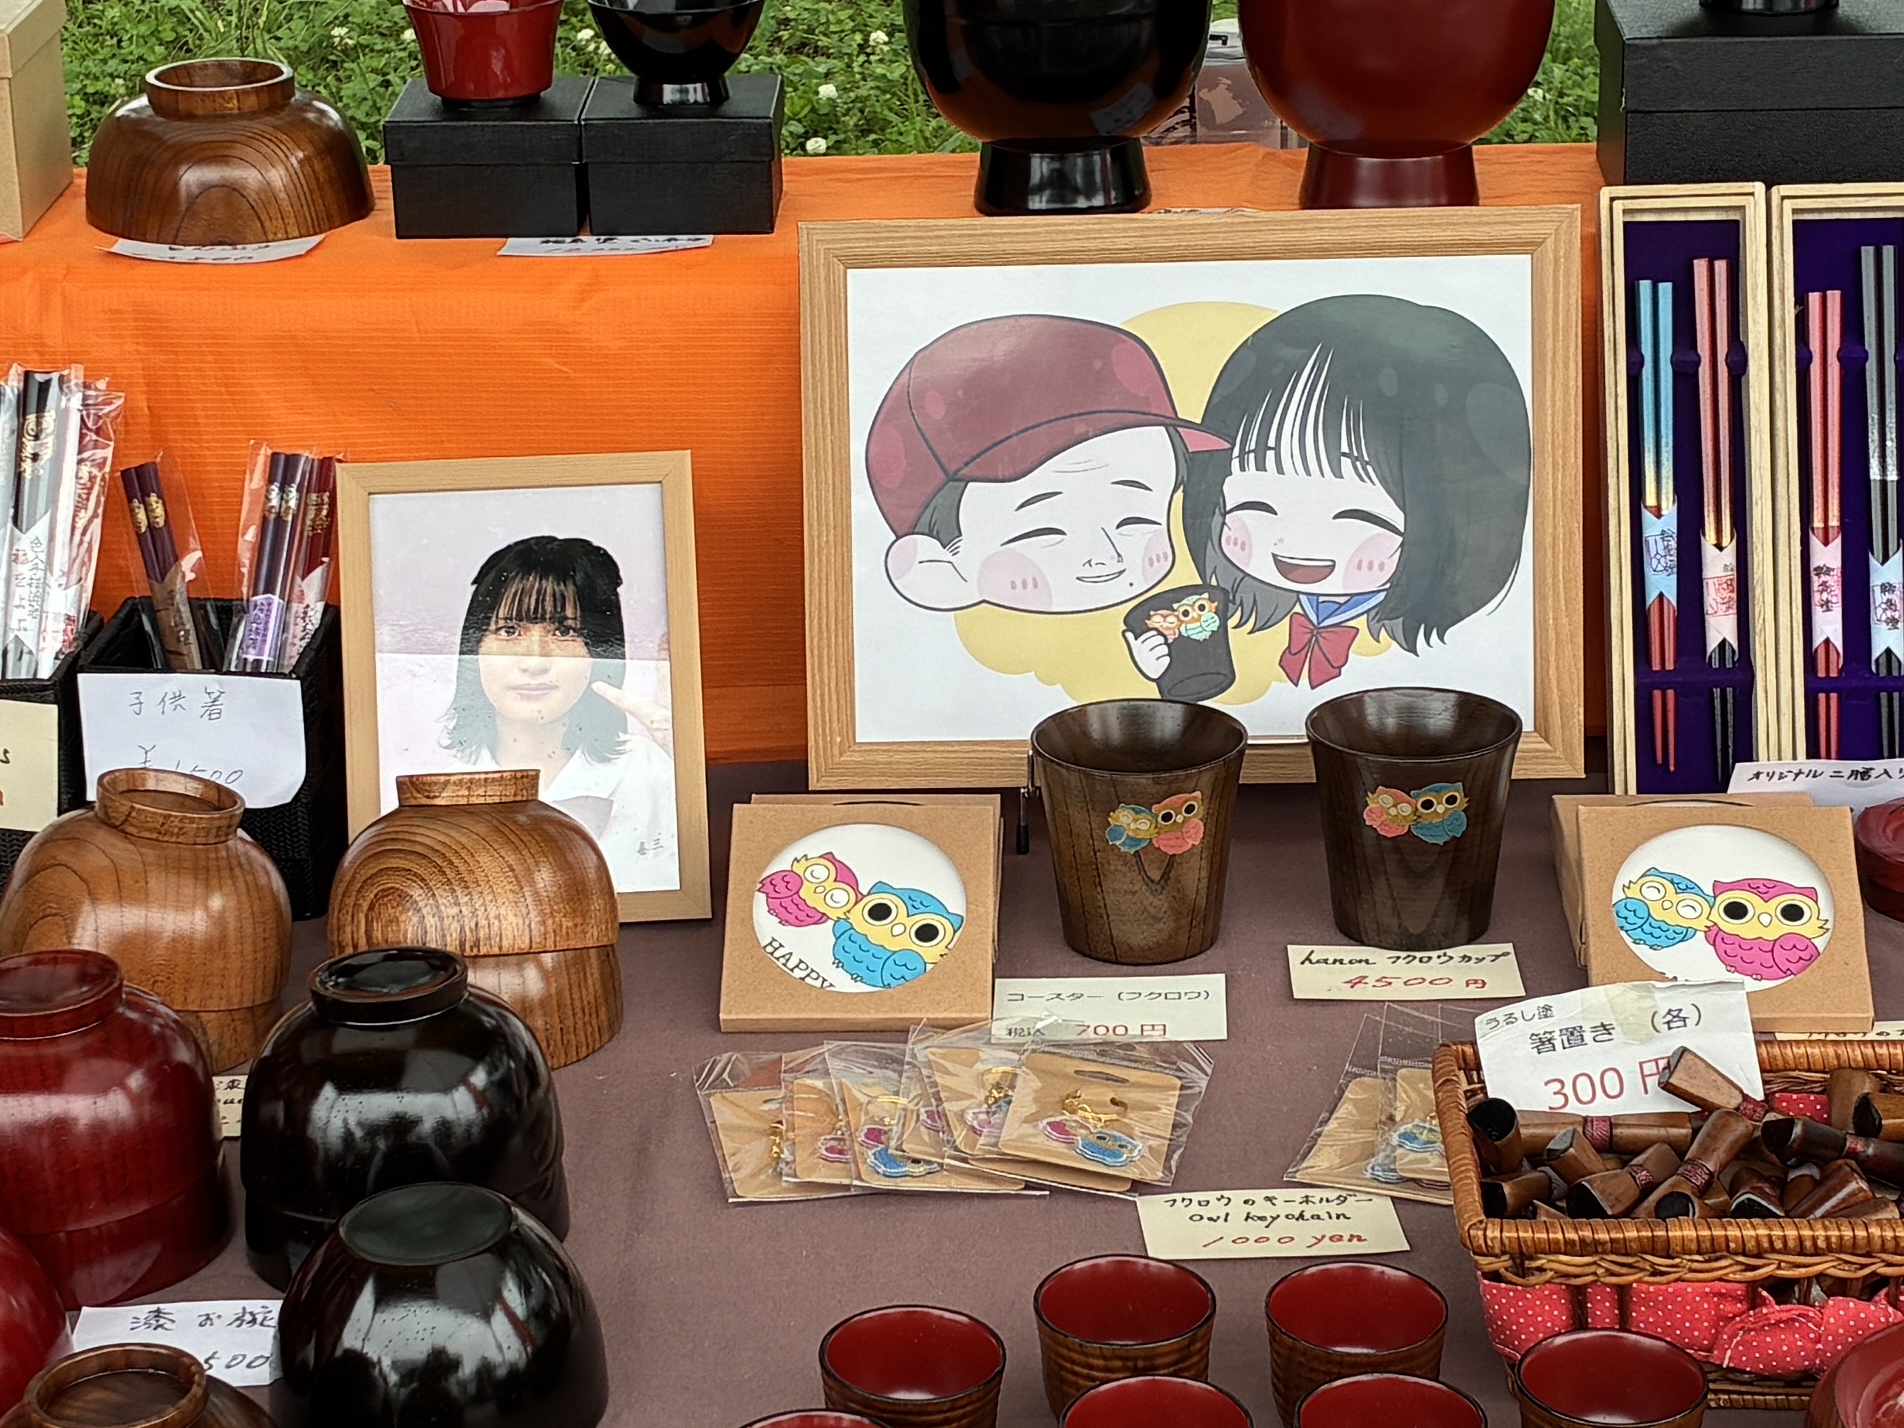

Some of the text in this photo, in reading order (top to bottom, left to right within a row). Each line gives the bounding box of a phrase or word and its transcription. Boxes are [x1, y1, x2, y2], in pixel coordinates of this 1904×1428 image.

[128, 686, 227, 722] 子供箸
[1485, 1003, 1557, 1031] うるし塗
[1529, 1021, 1617, 1056] 箸置き
[1543, 1066, 1626, 1112] 300
[1306, 1232, 1367, 1249] yen
